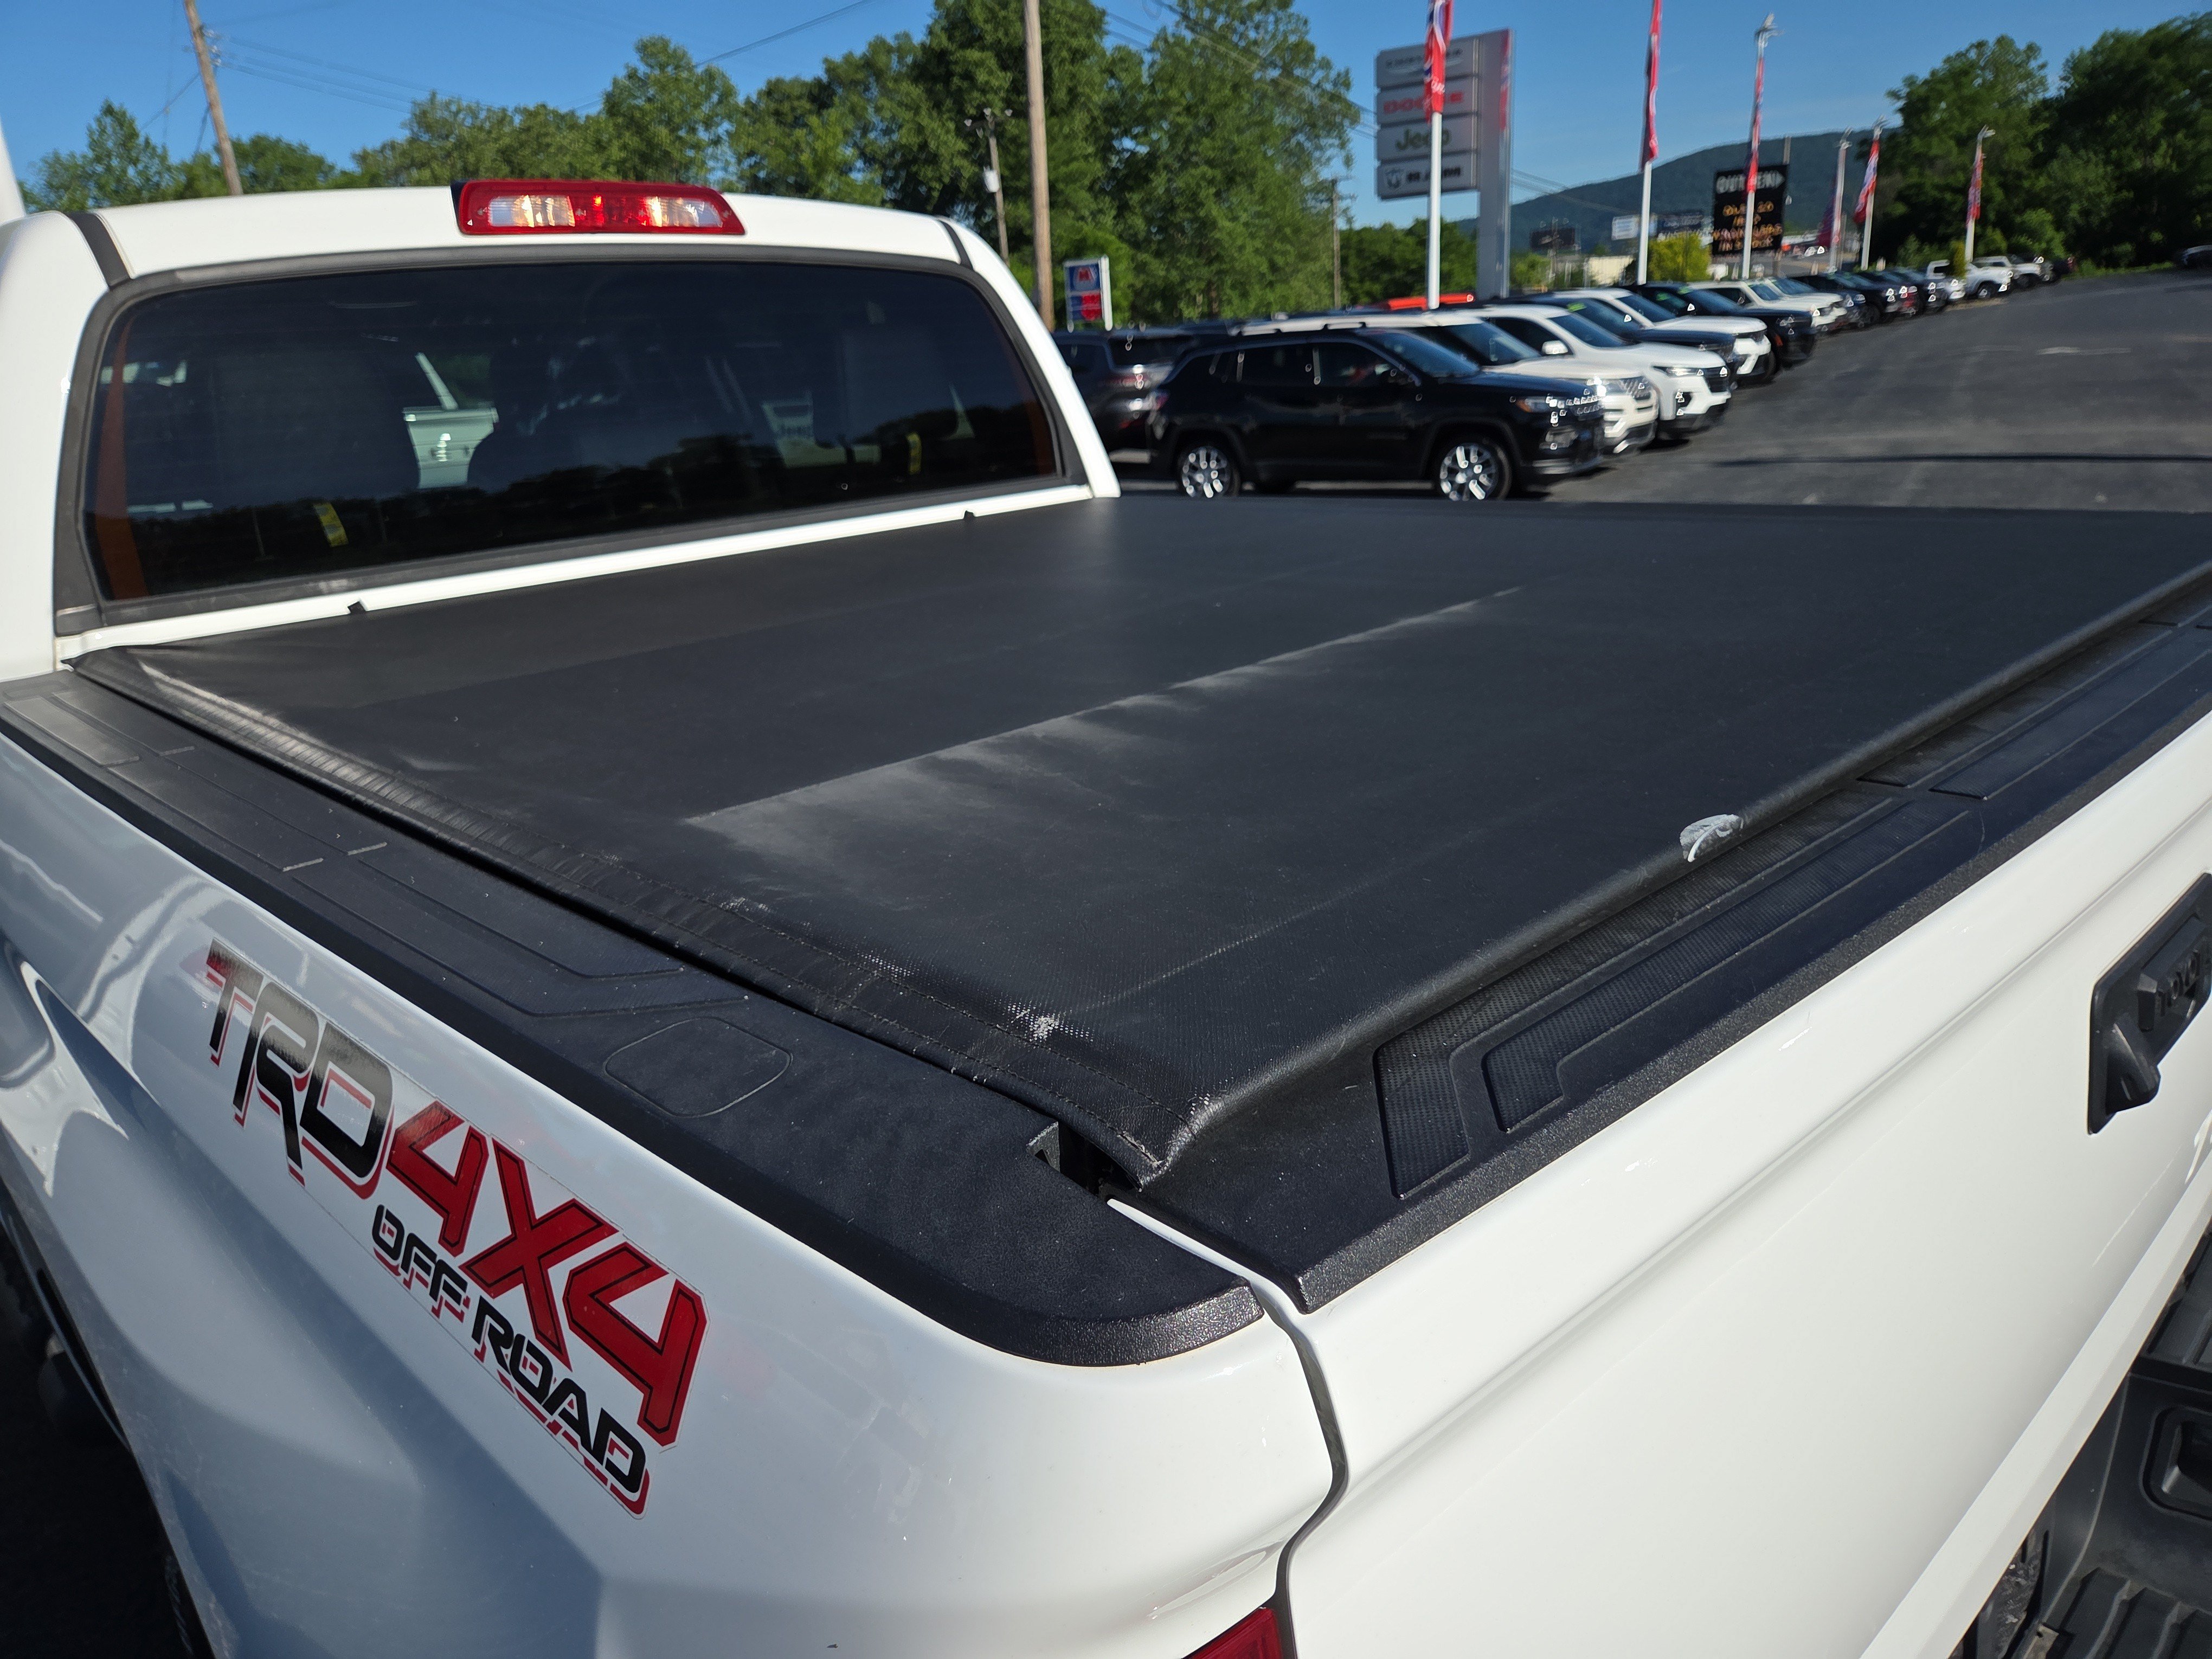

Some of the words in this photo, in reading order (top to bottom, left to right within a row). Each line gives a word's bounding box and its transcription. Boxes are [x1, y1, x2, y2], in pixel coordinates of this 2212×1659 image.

[206, 939, 395, 1199] TRD
[386, 1100, 707, 1447] 4X4
[372, 1204, 470, 1323] OFF
[472, 1295, 650, 1514] ROAD
